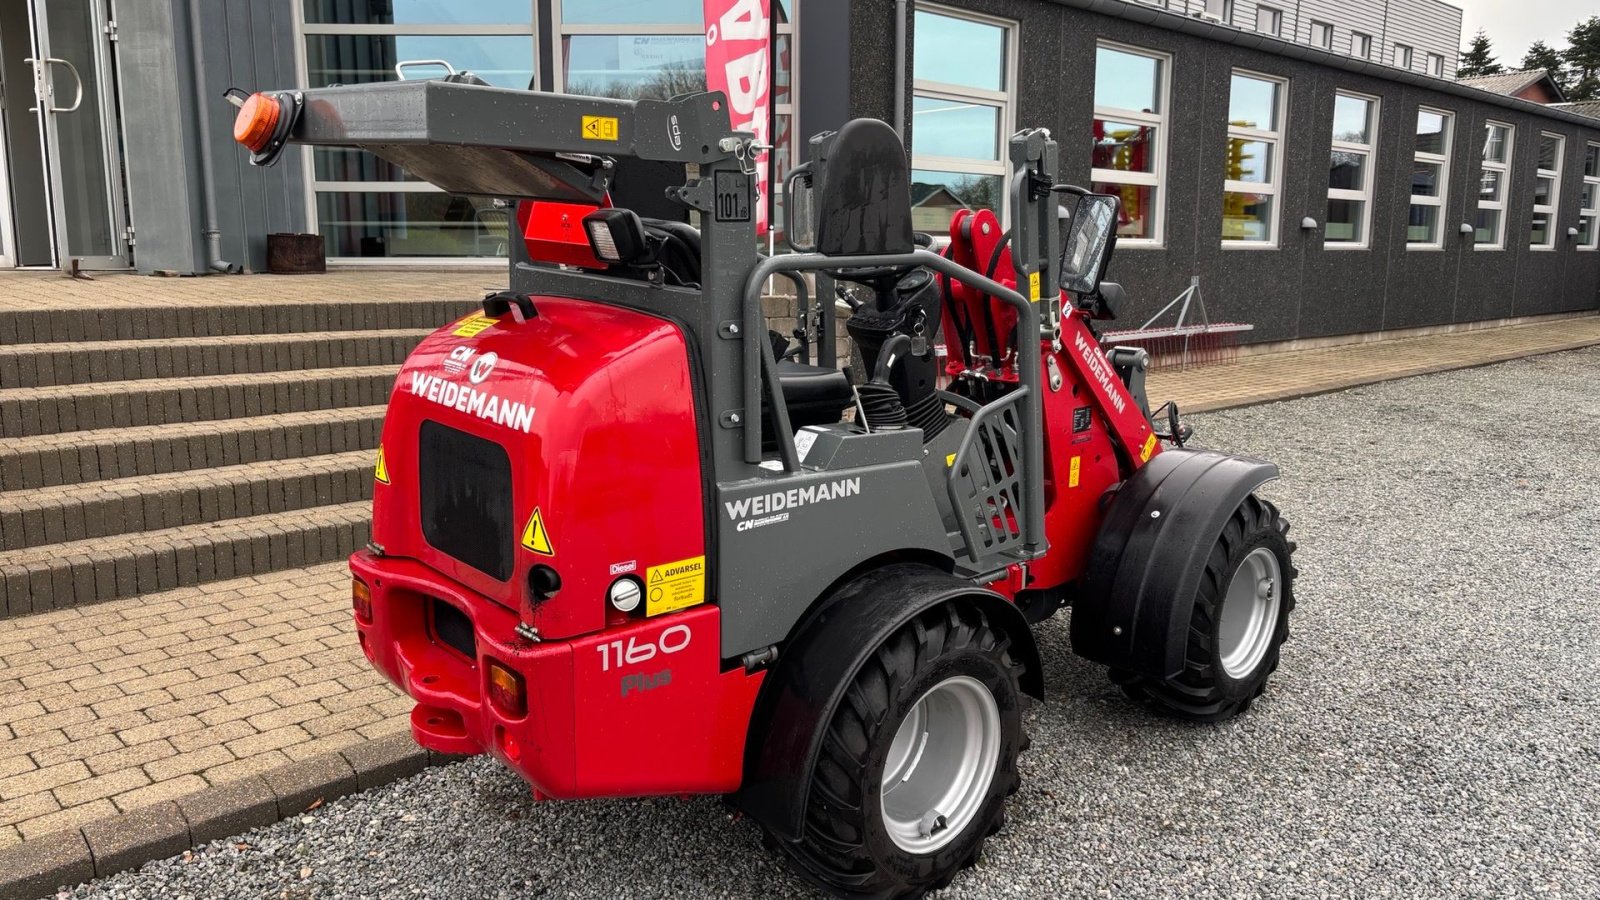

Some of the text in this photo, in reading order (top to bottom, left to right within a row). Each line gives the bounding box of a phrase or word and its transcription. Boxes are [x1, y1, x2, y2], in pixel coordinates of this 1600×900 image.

[719, 193, 738, 218] 101
[1075, 331, 1126, 415] WEIDEMANN
[411, 370, 537, 434] WEIDEMANN
[725, 477, 861, 521] WEIDEMANN
[736, 519, 754, 532] CN
[664, 562, 702, 578] ADVARSEL
[596, 624, 692, 672] 1160
[621, 668, 673, 699] Plus
